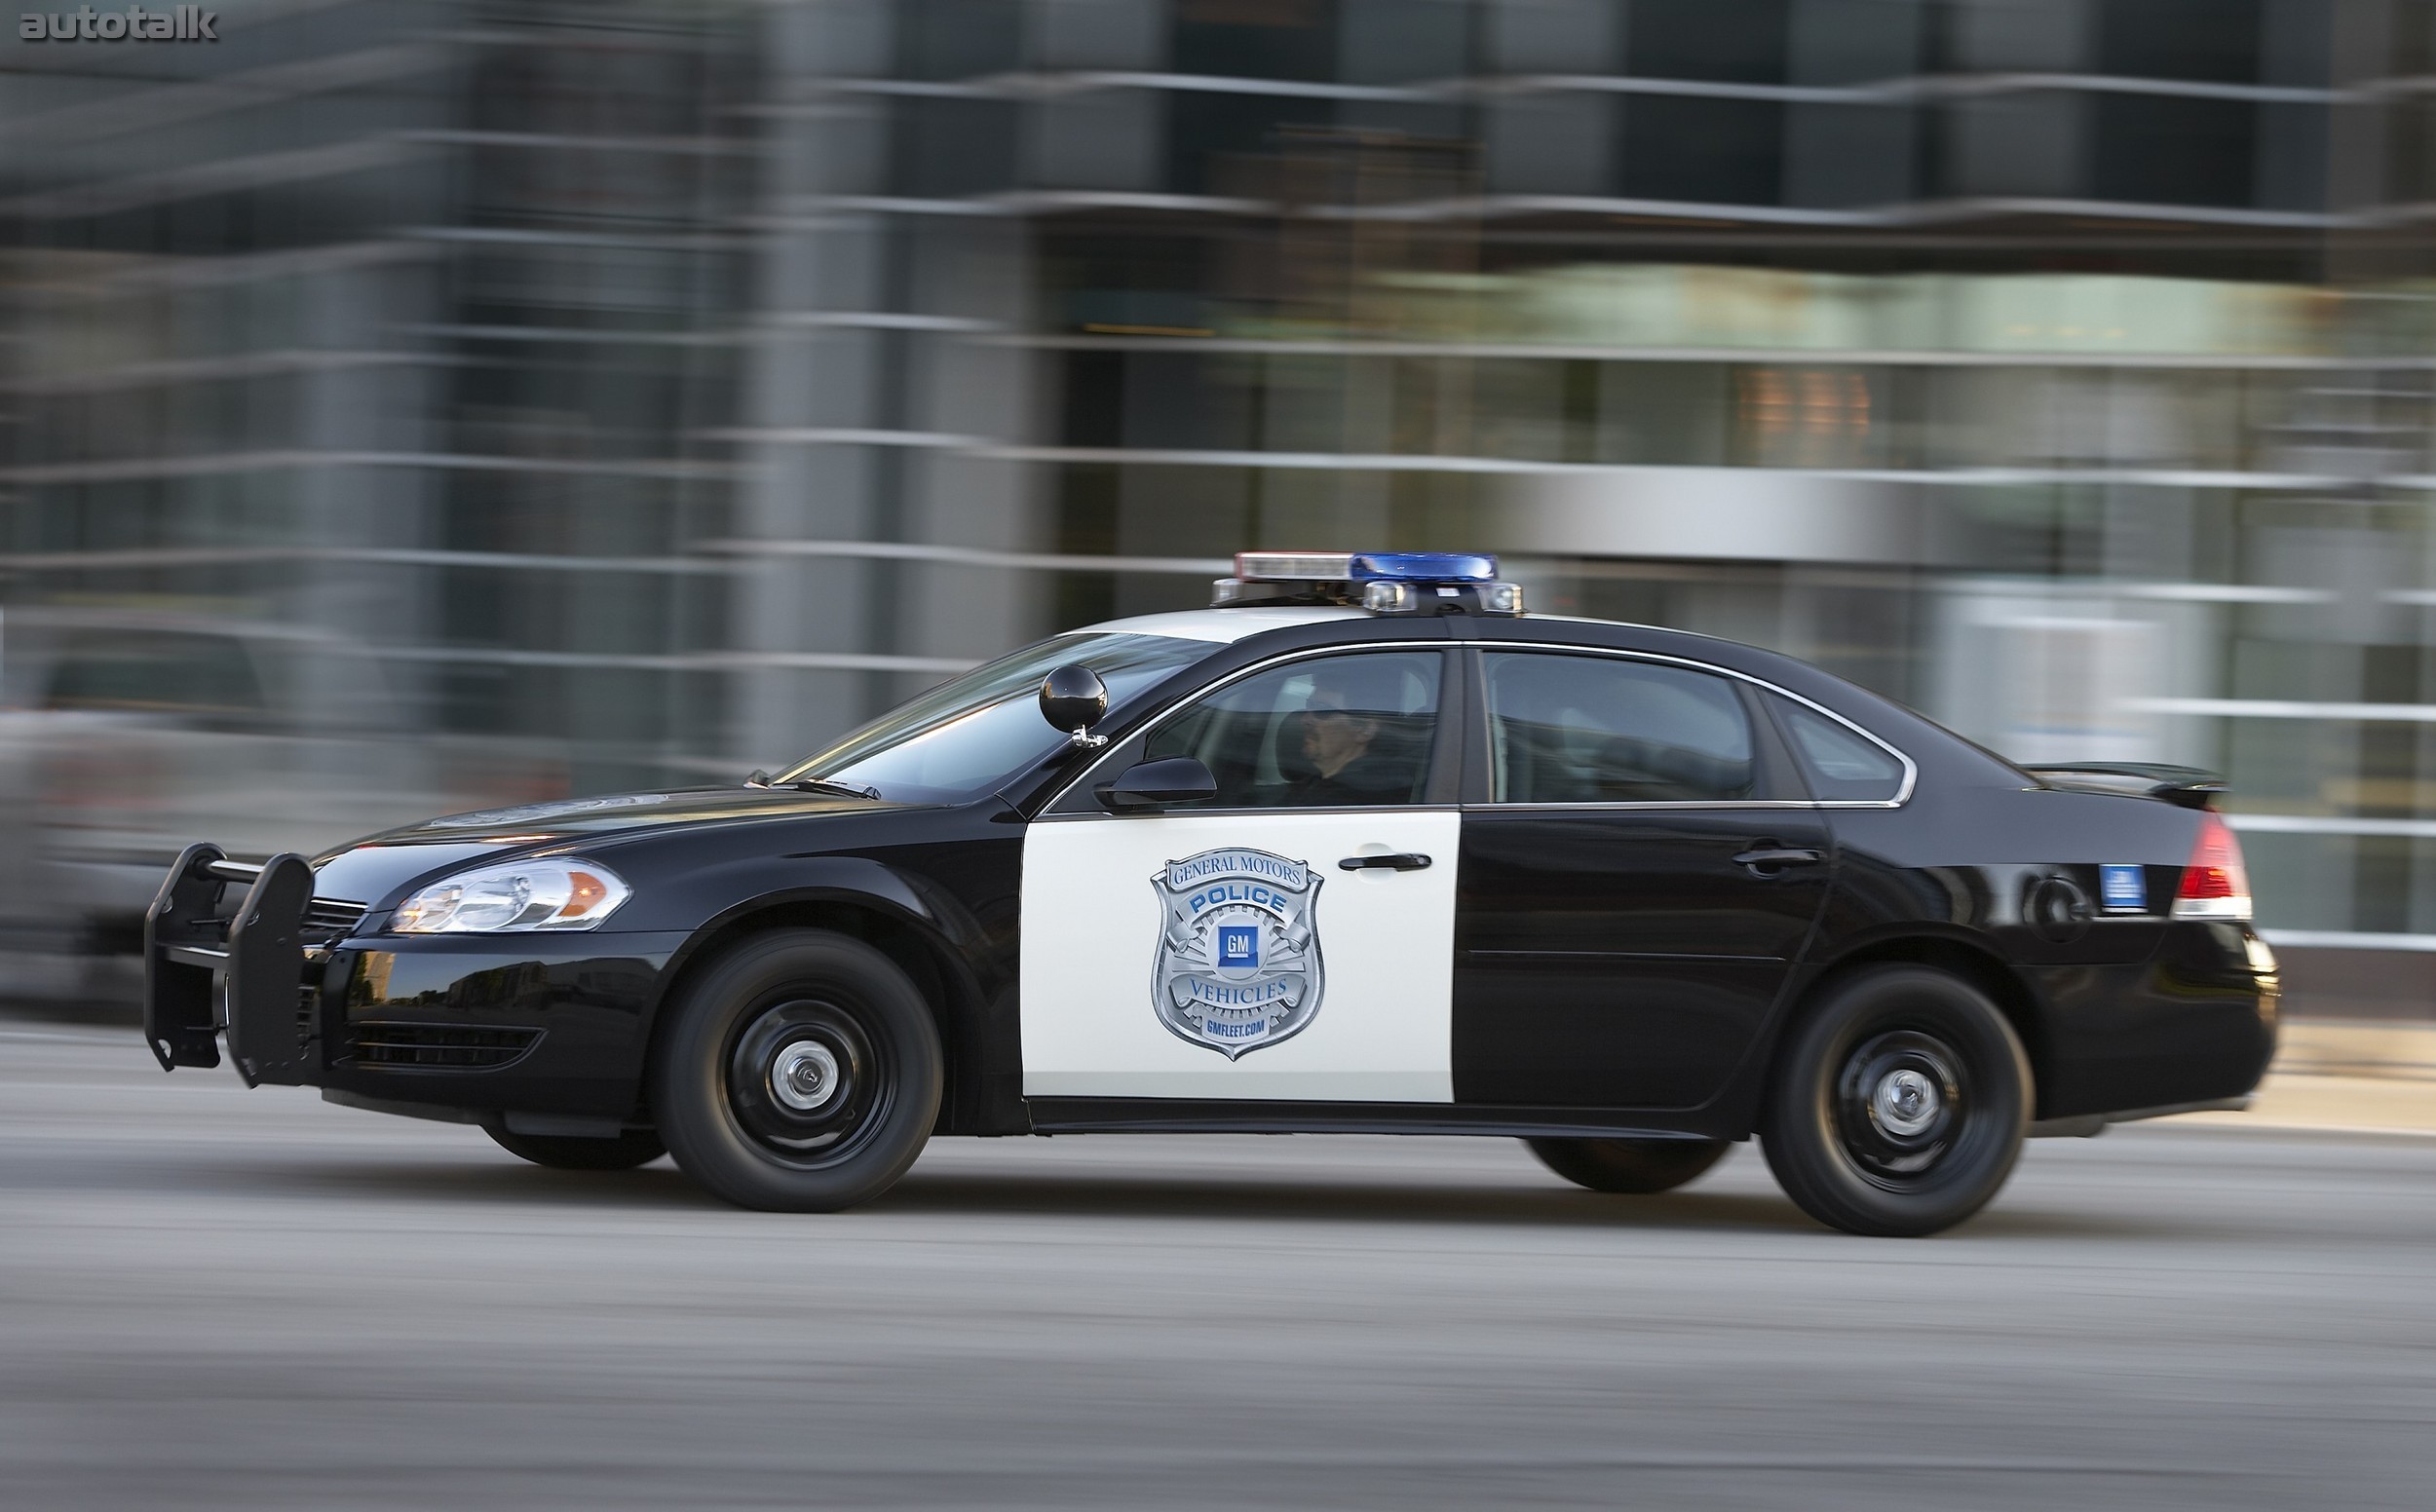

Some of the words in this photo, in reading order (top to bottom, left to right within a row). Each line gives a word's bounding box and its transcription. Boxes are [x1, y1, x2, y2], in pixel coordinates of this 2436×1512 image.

[1174, 856, 1237, 885] GENERAL
[1240, 856, 1301, 885] MOTORS
[1190, 885, 1287, 914] POLICE
[1228, 934, 1249, 953] GM
[1190, 978, 1287, 1004] VEHICLES
[1207, 1019, 1265, 1038] GMFLEET.COM
